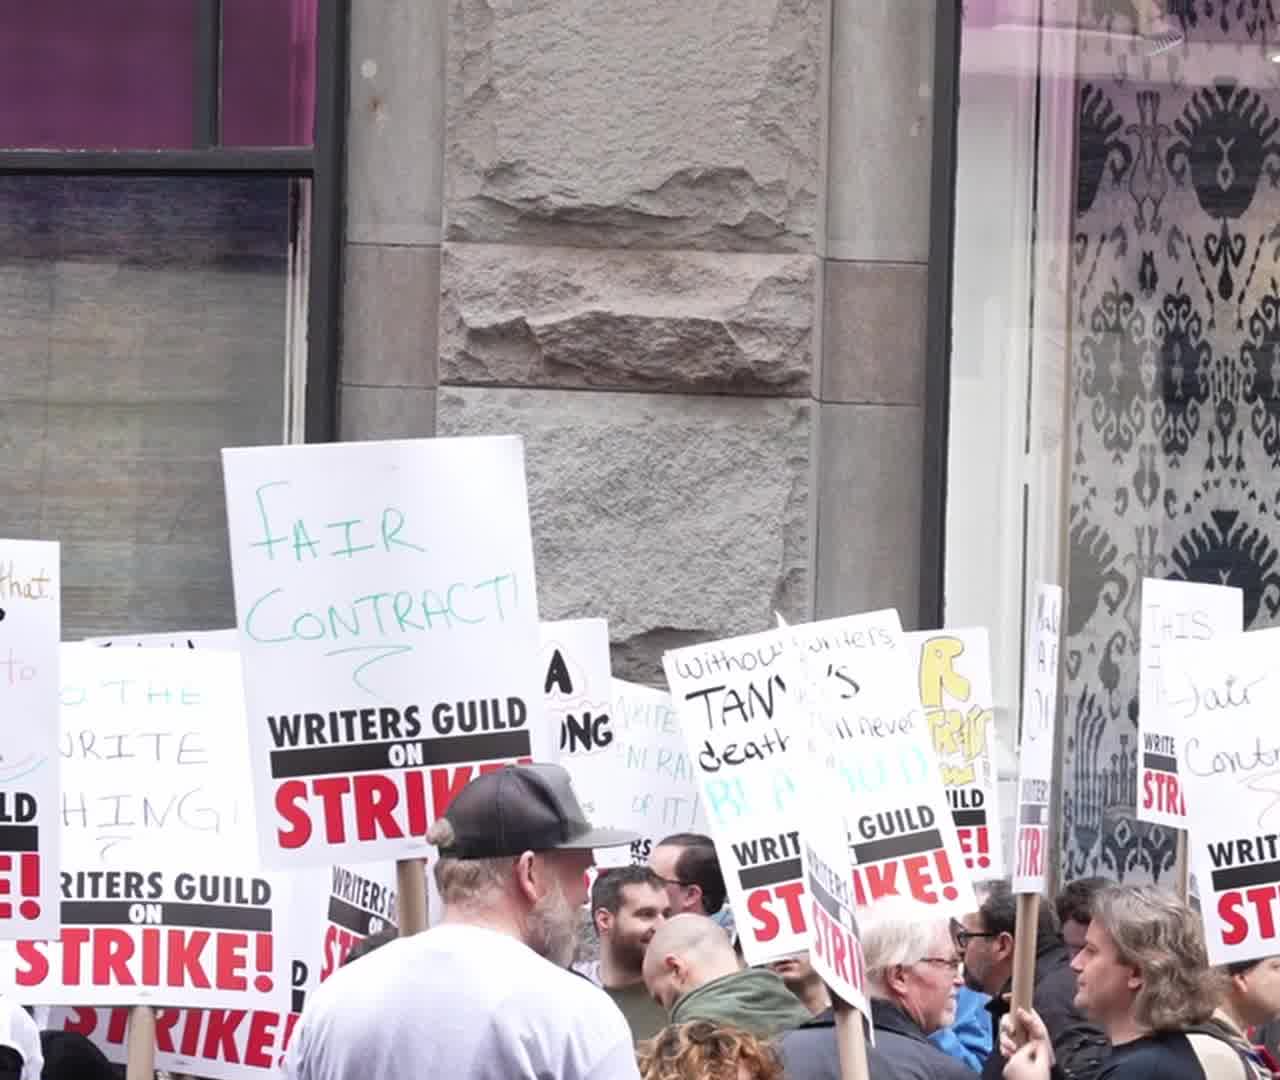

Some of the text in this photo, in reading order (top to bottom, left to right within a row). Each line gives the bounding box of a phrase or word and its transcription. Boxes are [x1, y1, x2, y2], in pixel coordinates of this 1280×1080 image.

[250, 480, 427, 561] FAIR
[267, 697, 527, 748] WRITERS GUILD
[388, 743, 423, 767] ON
[1144, 732, 1175, 755] WRITE
[946, 789, 985, 809] ILD
[732, 805, 936, 867] WRIT GUILD
[60, 872, 163, 899] RITERS
[174, 873, 272, 905] GUILD
[128, 904, 163, 924] ON
[15, 928, 273, 993] STRIKE!
